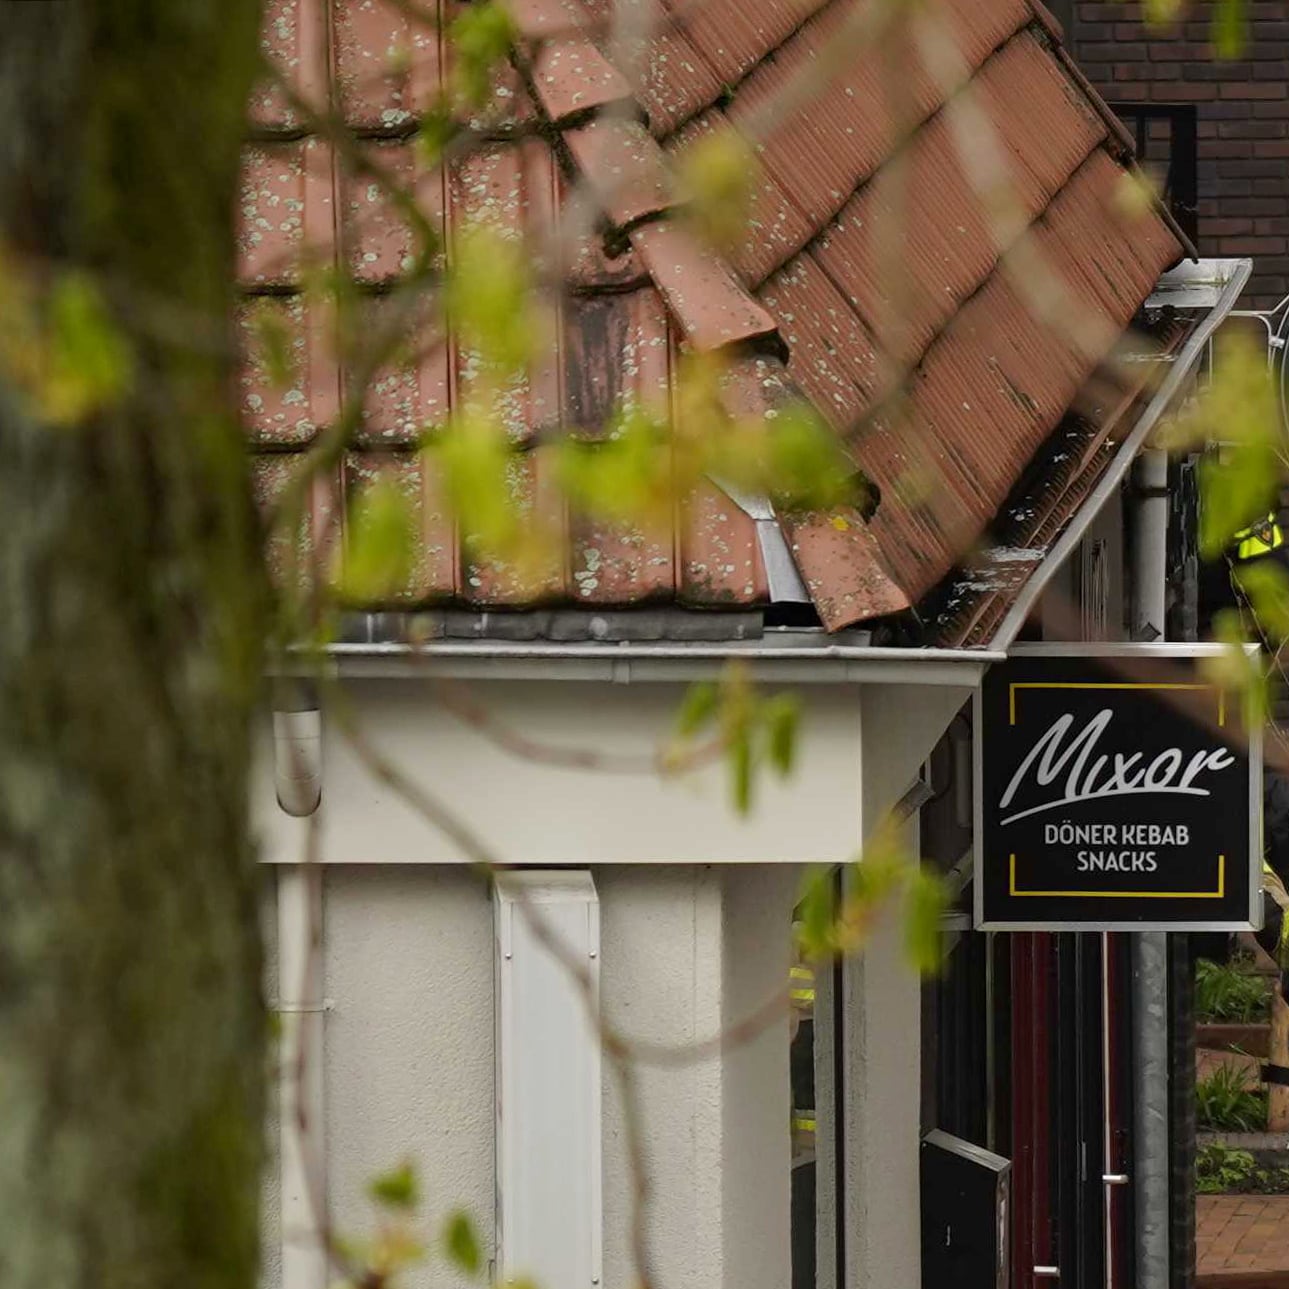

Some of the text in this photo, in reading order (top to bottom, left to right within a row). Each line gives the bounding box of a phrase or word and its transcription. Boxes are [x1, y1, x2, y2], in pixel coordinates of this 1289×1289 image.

[999, 708, 1236, 810] Mixor
[1044, 819, 1190, 845] DÖNER KEBAB
[1076, 850, 1158, 872] SNACKS
